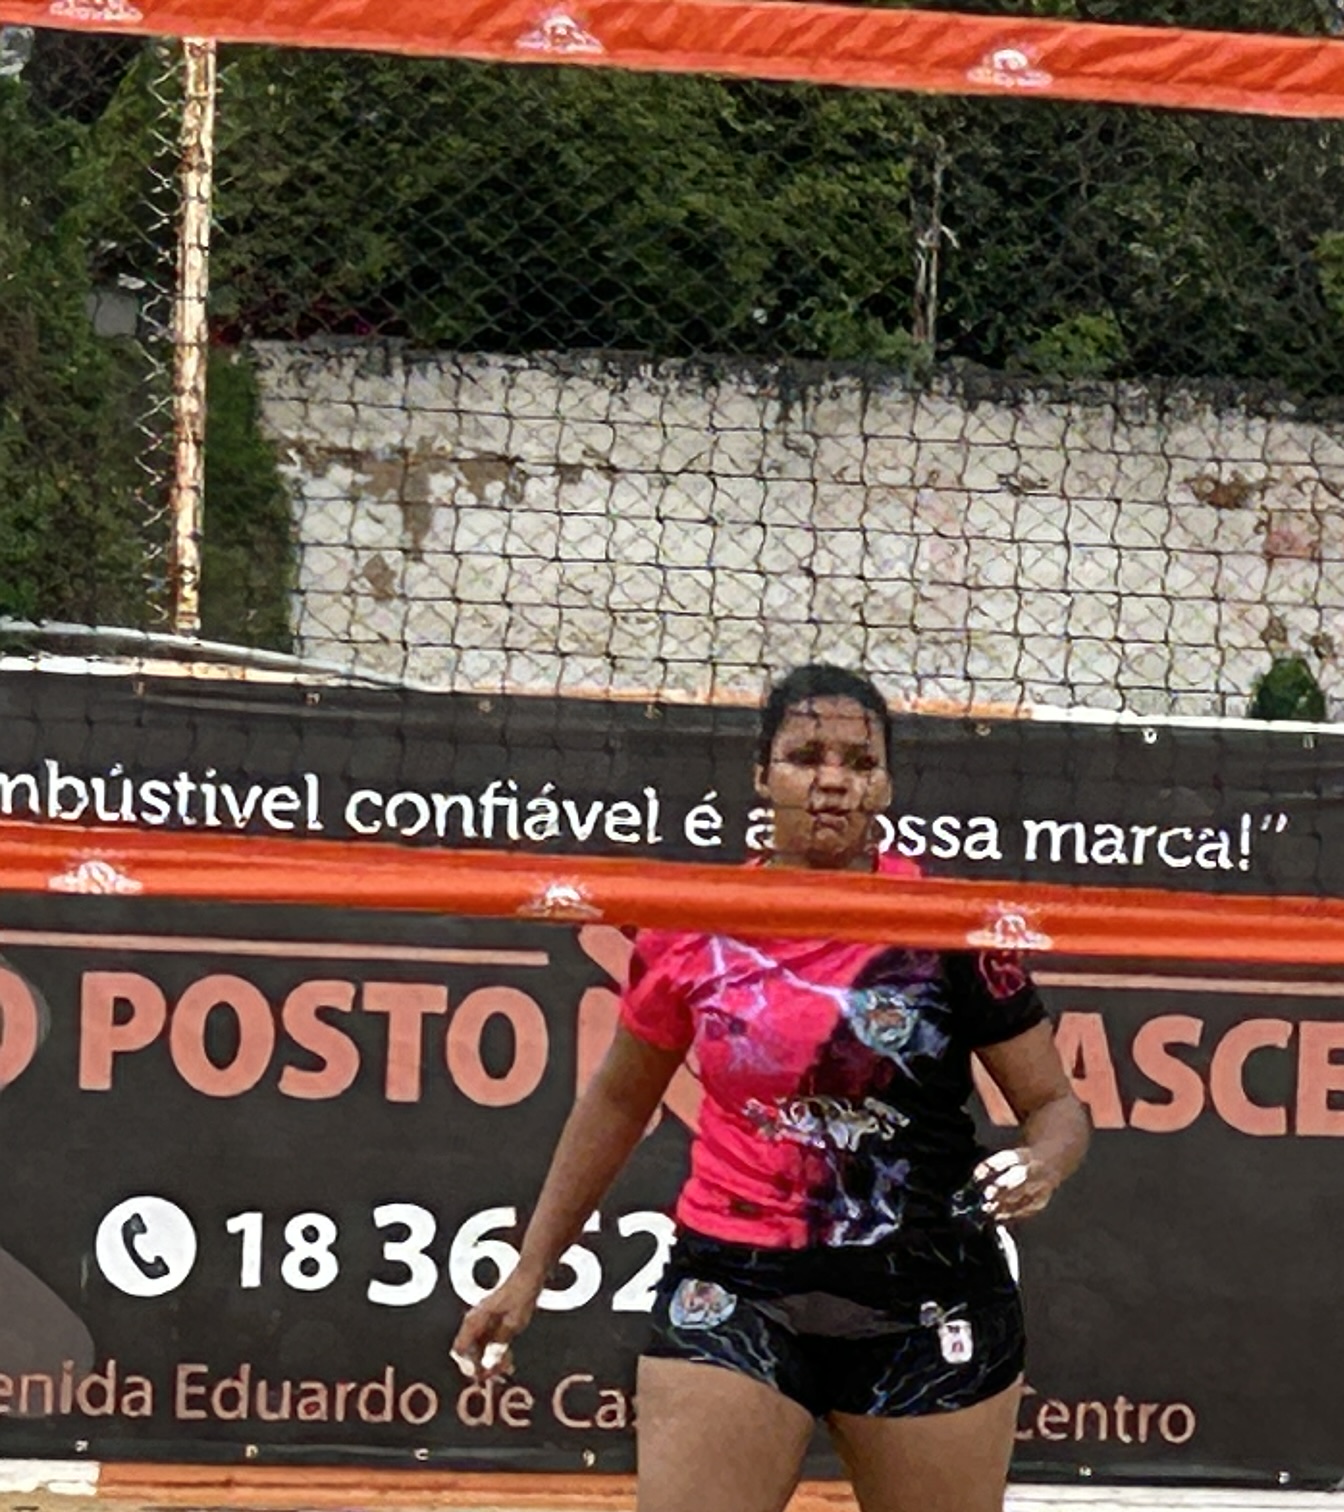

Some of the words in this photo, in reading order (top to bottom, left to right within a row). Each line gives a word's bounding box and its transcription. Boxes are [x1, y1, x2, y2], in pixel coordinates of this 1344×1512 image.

[344, 780, 663, 844] confiável
[683, 790, 723, 847] é
[79, 971, 549, 1107] POSTO
[225, 1211, 339, 1292] 18
[175, 1363, 439, 1425] Eduardo
[456, 1376, 535, 1428] de
